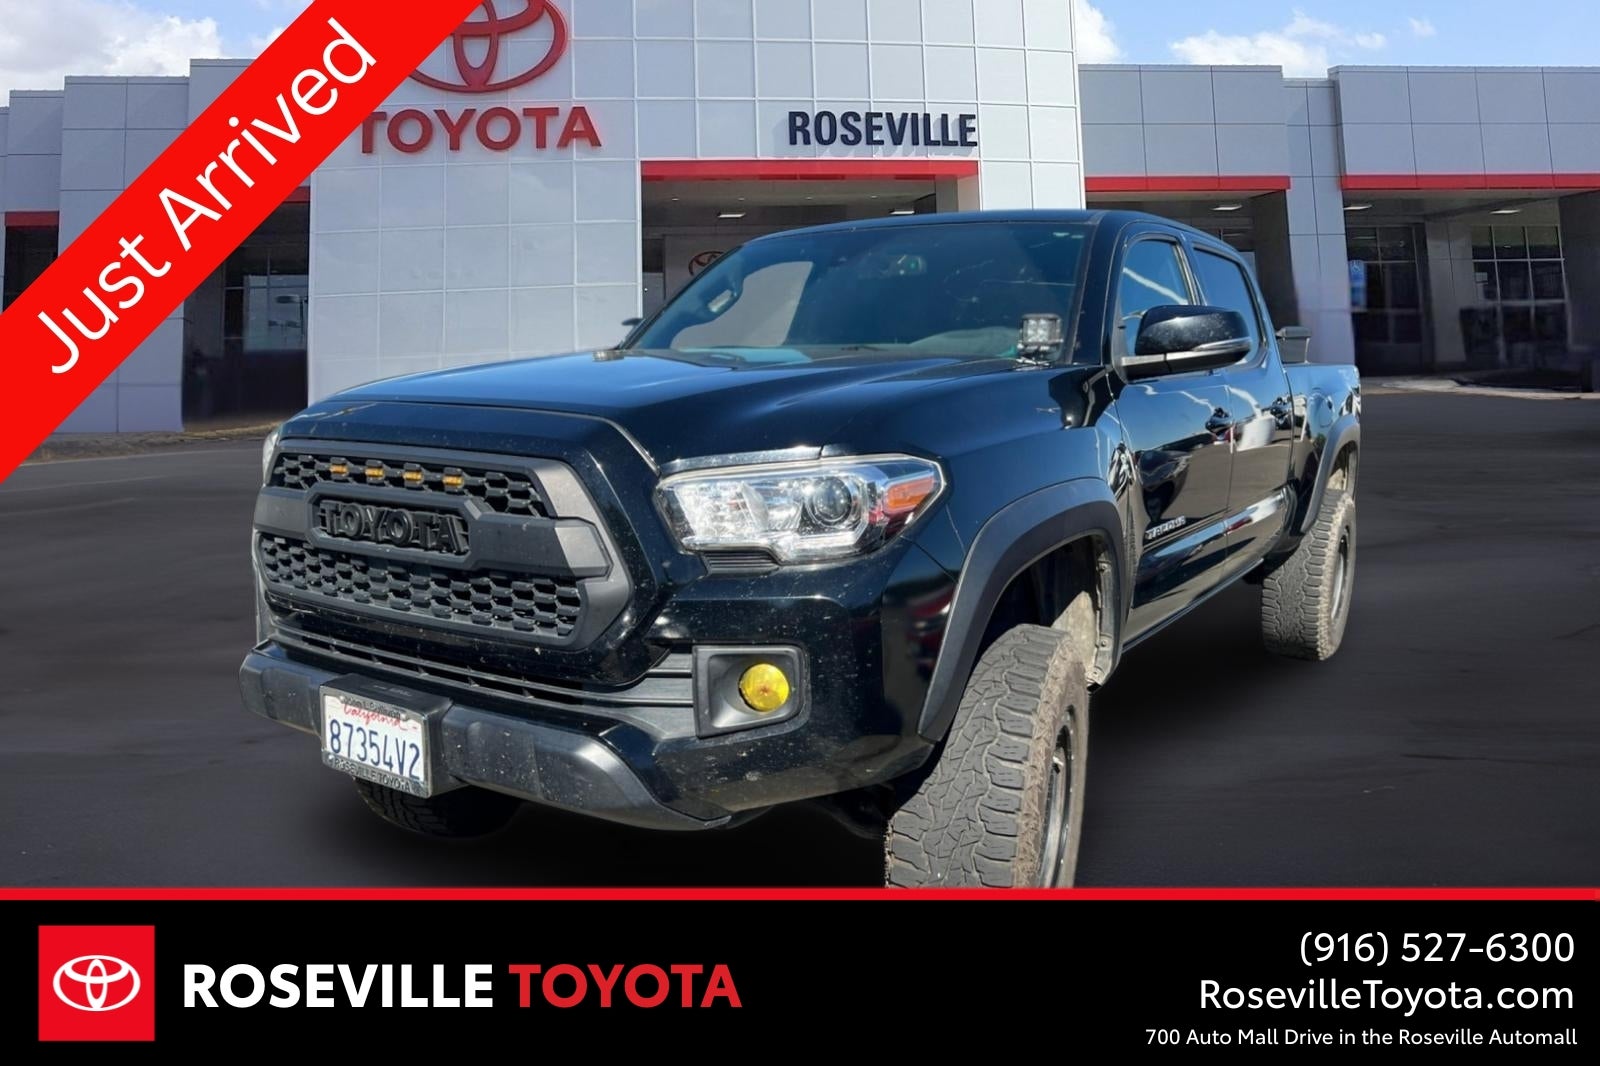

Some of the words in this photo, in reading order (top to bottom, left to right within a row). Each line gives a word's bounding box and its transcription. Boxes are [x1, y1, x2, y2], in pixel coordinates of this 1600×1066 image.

[361, 106, 602, 154] TOYOTA
[788, 110, 978, 147] ROSEVILLE
[320, 499, 469, 554] TOYOTA
[330, 718, 420, 781] 87354V2
